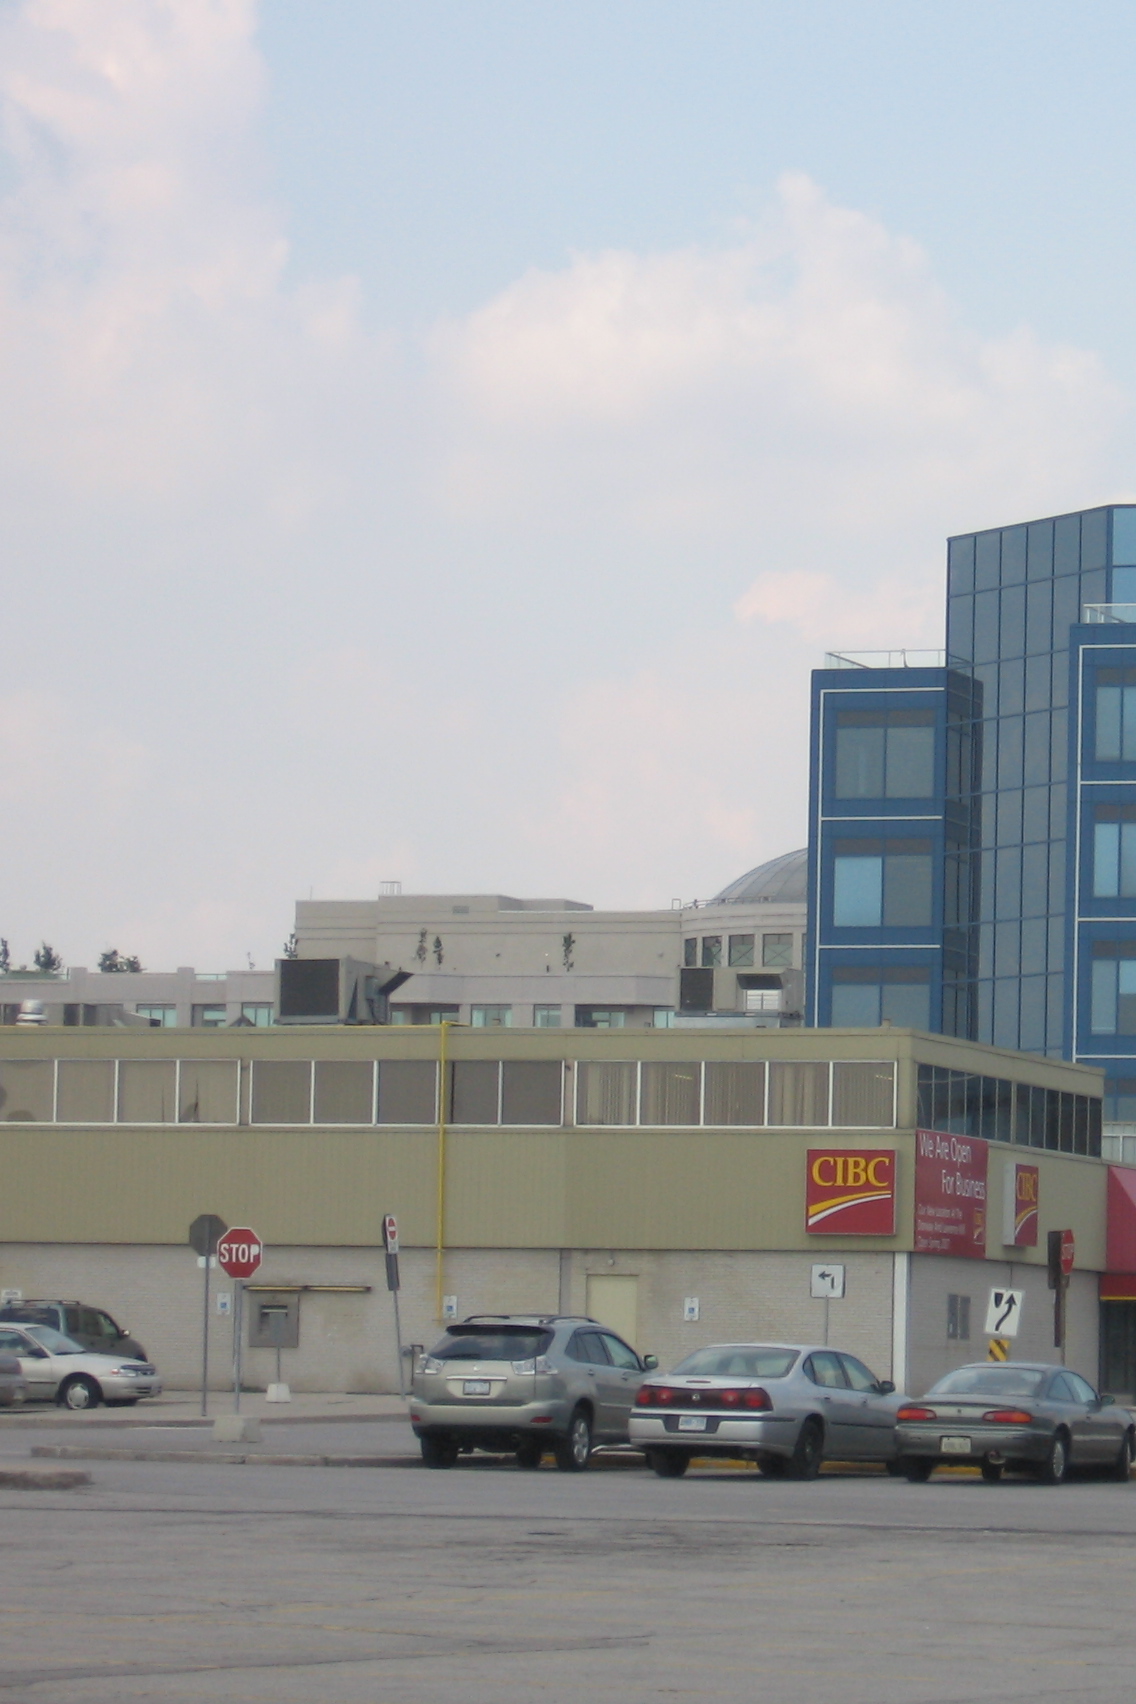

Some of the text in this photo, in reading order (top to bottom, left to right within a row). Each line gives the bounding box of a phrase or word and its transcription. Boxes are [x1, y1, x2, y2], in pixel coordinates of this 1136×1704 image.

[920, 1133, 972, 1168] We Are Open
[812, 1156, 890, 1187] CIBC
[941, 1169, 985, 1200] For Business
[1016, 1172, 1038, 1202] CIBC
[220, 1243, 260, 1263] STOP
